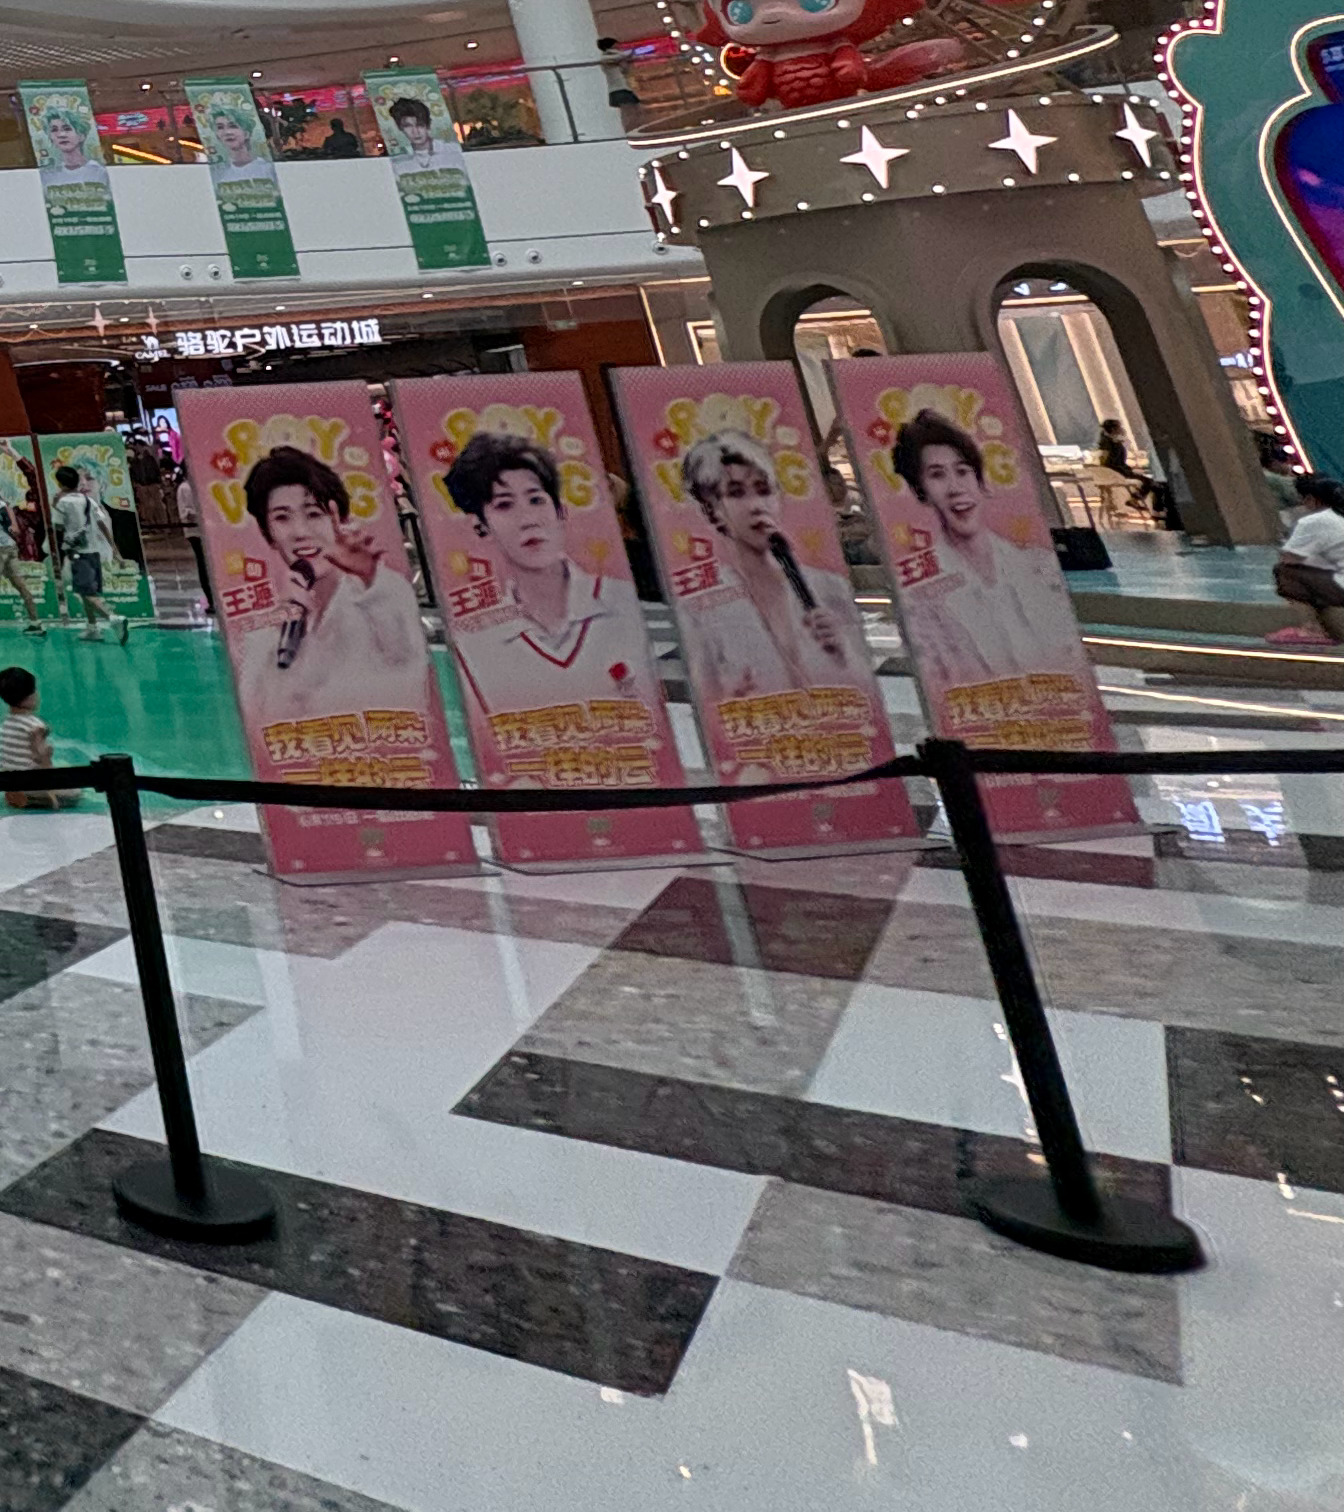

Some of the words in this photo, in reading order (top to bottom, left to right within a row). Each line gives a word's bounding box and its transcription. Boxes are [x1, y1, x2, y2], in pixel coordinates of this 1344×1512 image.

[176, 319, 382, 356] 骆驼户外运动城
